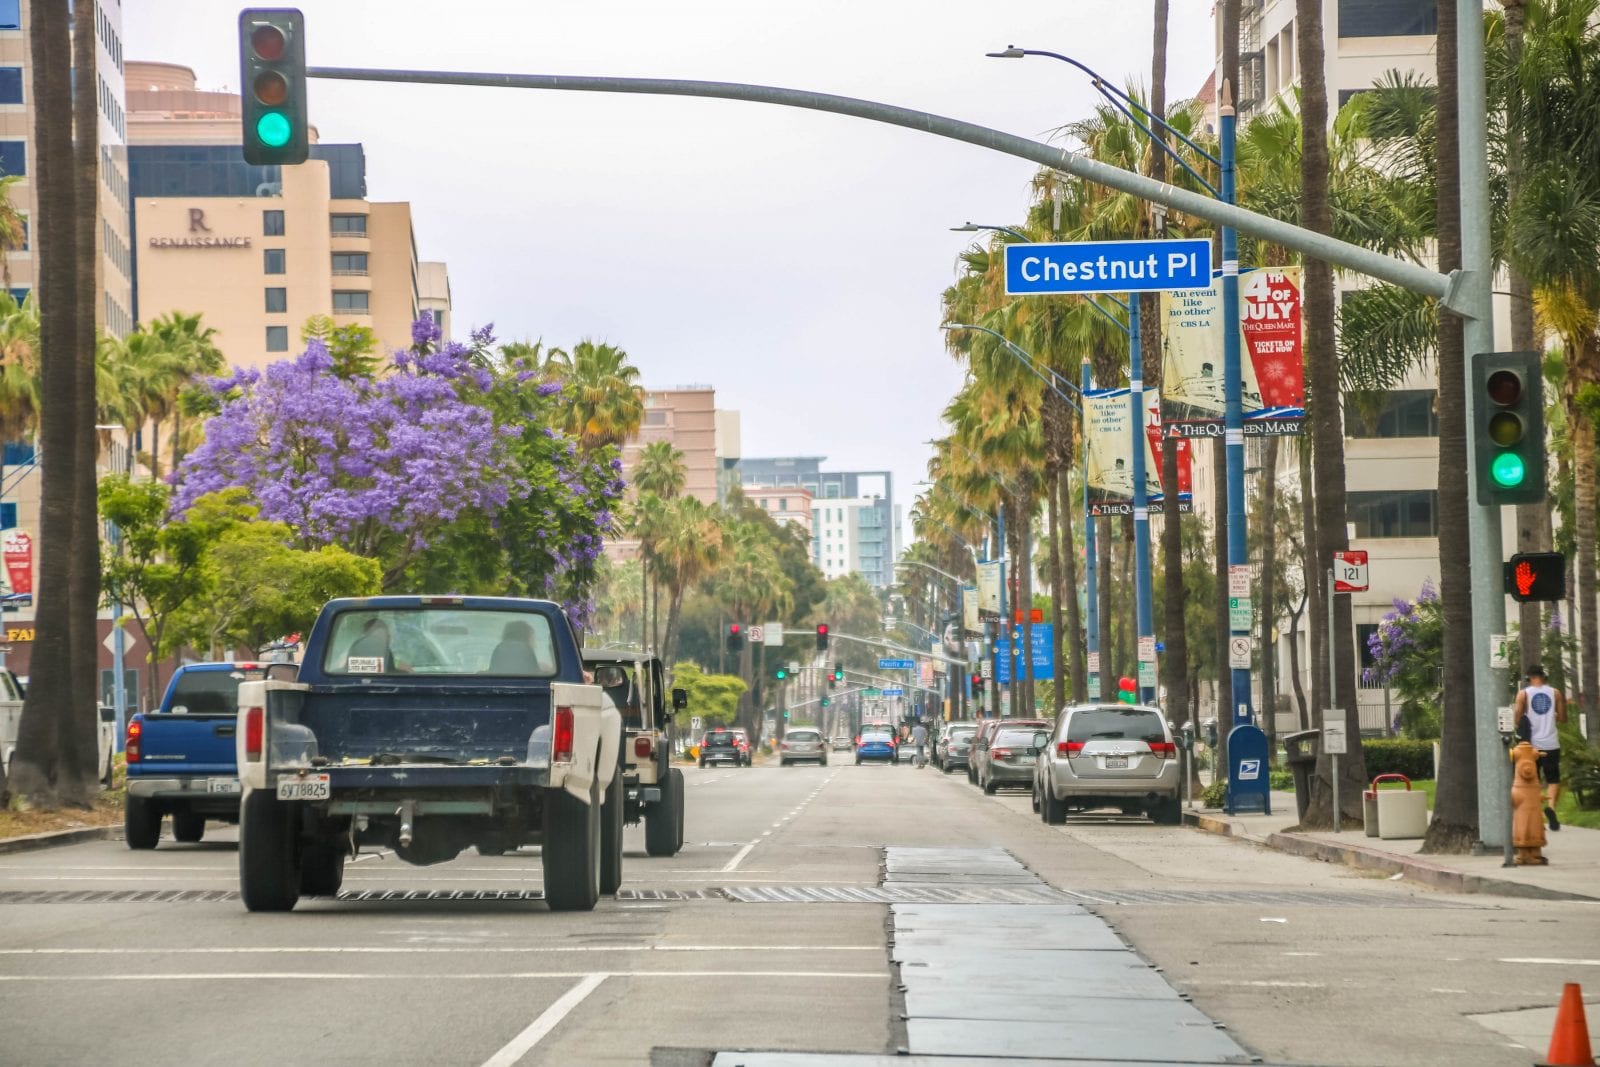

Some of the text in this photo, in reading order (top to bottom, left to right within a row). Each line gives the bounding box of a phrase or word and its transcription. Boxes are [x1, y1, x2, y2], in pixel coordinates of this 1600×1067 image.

[188, 208, 211, 231] R
[149, 237, 252, 248] RENAISSANCE
[1021, 252, 1196, 282] Chestnut Pl
[1189, 289, 1217, 297] event
[1272, 290, 1291, 301] OF
[1183, 299, 1203, 307] like
[1240, 302, 1294, 320] JULY
[1180, 320, 1197, 328] CBS
[1243, 323, 1256, 331] THE
[1255, 322, 1276, 331] QUEEN
[1181, 424, 1205, 435] THE
[1265, 422, 1300, 434] MARY
[1101, 504, 1119, 513] THE
[1344, 567, 1359, 581] 121
[1231, 600, 1237, 608] 2
[8, 628, 35, 641] FA
